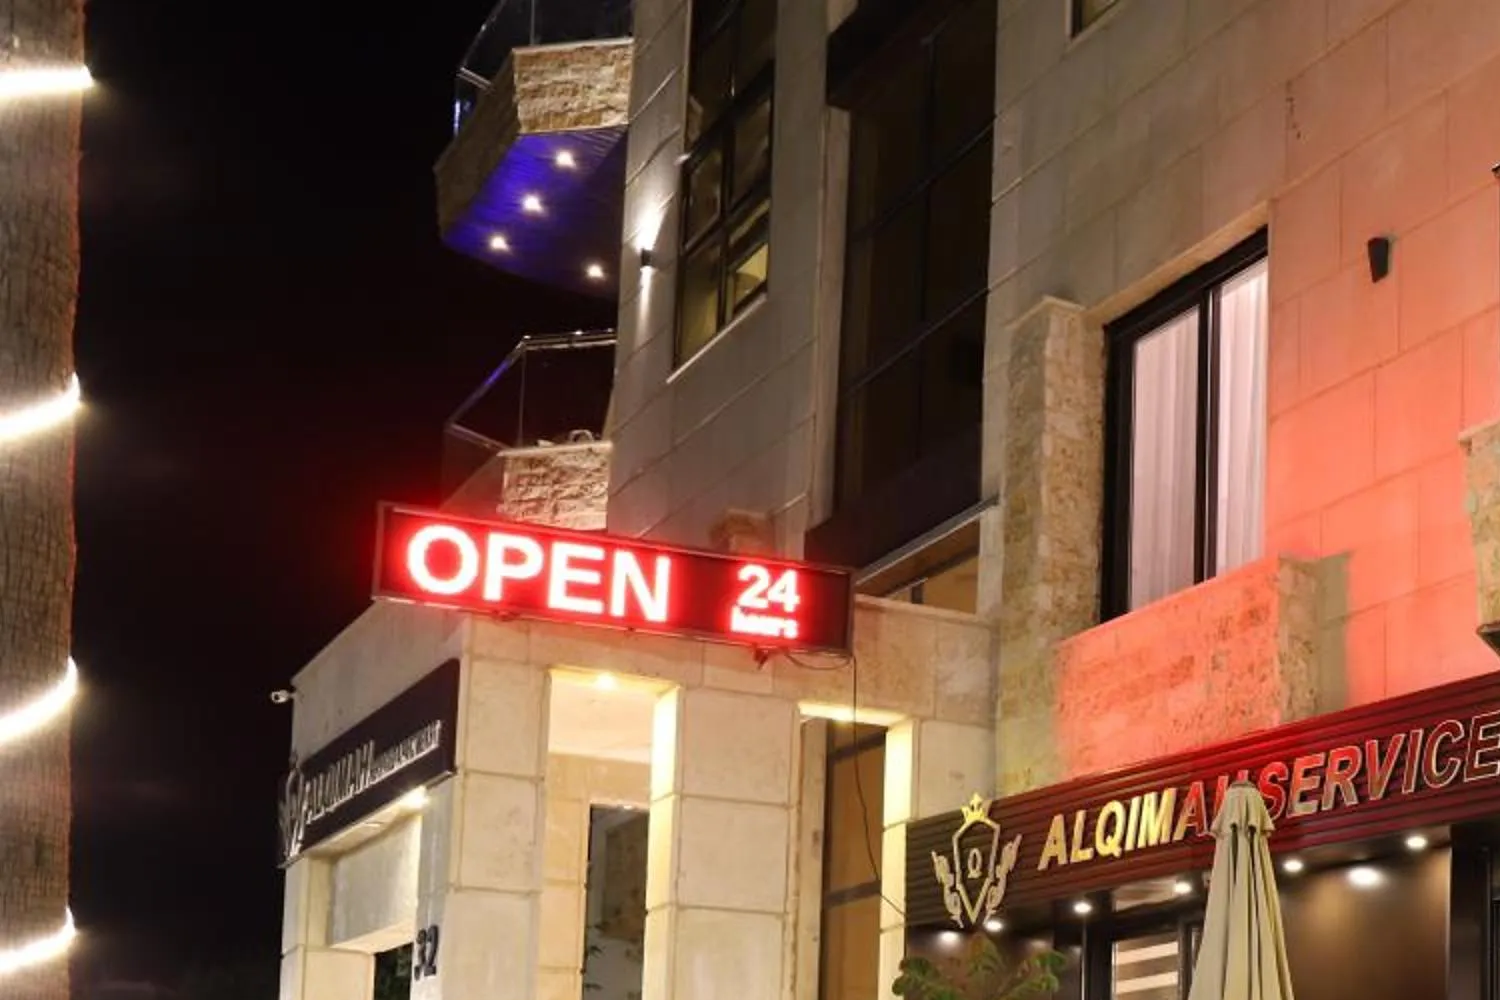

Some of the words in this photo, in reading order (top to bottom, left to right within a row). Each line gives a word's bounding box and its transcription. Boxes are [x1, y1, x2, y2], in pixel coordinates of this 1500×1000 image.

[406, 523, 672, 623] OPEN
[737, 563, 801, 613] 24
[1036, 769, 1250, 872] ALQIMA
